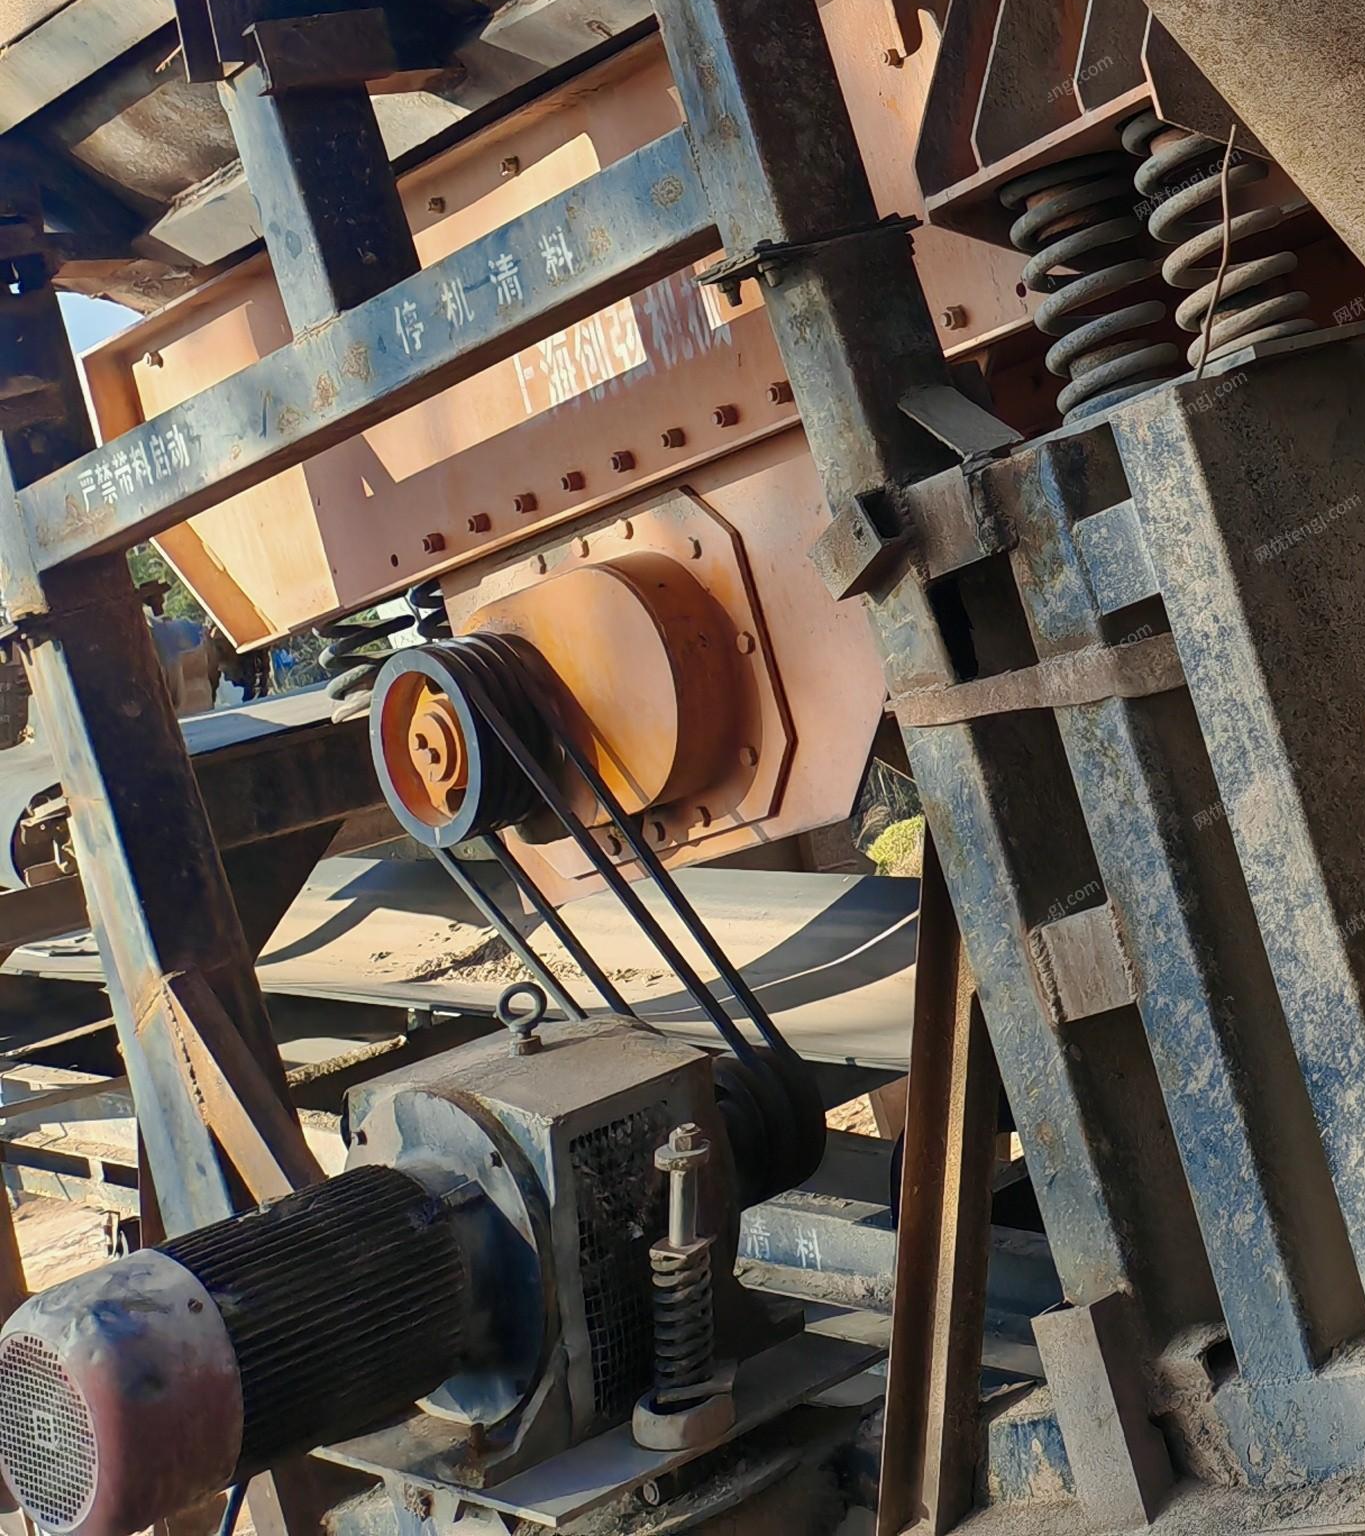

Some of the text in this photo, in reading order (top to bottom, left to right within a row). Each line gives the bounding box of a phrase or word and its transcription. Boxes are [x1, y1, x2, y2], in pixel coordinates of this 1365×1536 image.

[394, 226, 574, 355] 停机清料
[77, 424, 190, 513] 严禁带料启动
